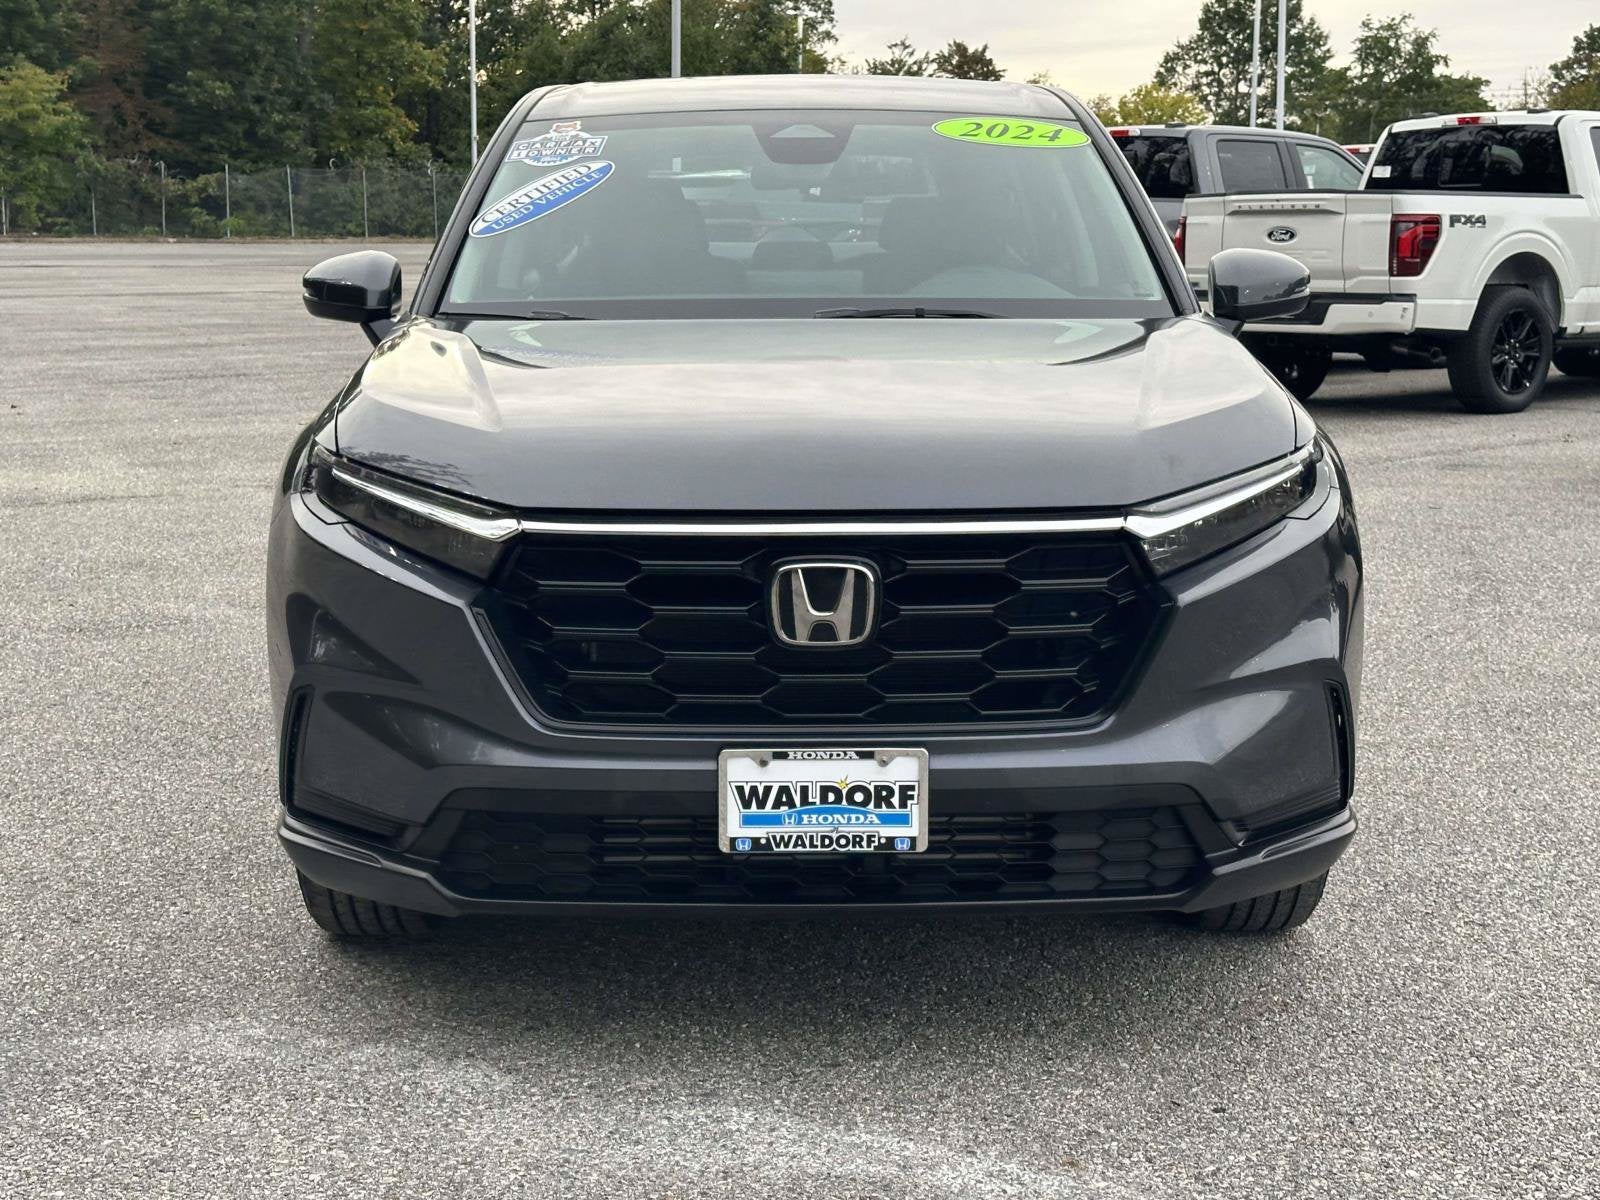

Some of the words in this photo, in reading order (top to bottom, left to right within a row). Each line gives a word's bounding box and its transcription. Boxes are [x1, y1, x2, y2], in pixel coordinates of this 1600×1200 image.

[958, 122, 1064, 142] 2024
[518, 138, 600, 150] CARFAX
[529, 147, 596, 157] OWNER
[481, 164, 592, 223] CERTIFIED
[491, 204, 534, 230] USED
[535, 171, 604, 206] VEHICLE
[1449, 214, 1487, 228] FX4
[1270, 229, 1292, 241] Ford
[787, 751, 860, 760] HONDA
[734, 784, 916, 811] WALDORF
[801, 813, 881, 825] HONDA
[771, 834, 878, 849] WALDORF
